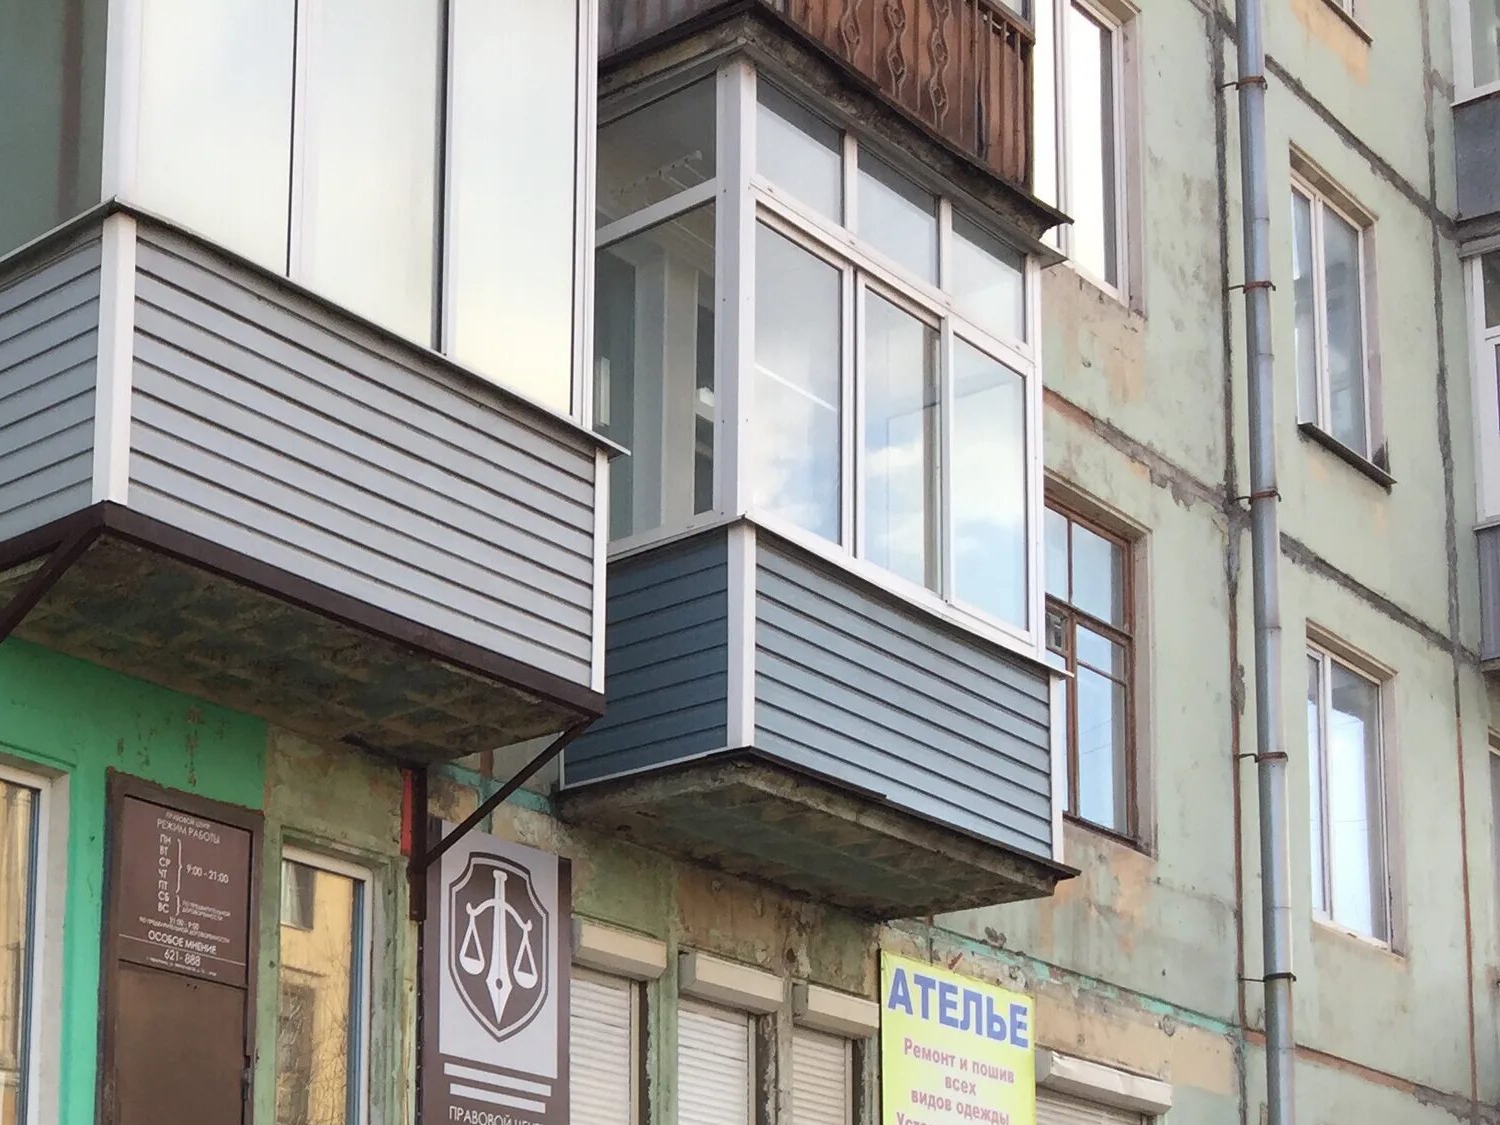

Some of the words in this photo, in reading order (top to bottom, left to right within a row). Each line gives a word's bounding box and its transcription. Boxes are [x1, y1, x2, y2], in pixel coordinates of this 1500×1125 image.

[156, 818, 187, 836] РЕЖИМ
[188, 827, 221, 845] РАБОТЫ
[159, 834, 172, 845] ПН
[159, 845, 169, 856] ВТ
[158, 856, 171, 867] СР
[158, 869, 168, 879] ЧТ
[186, 863, 203, 877] 9:00
[158, 880, 169, 891] ПТ
[157, 890, 170, 902] СБ
[157, 902, 170, 914] ВС
[148, 929, 184, 948] ОСОБОЕ
[185, 939, 218, 955] МНЕНИЕ
[887, 967, 1029, 1049] АТЕЛЬЕ
[904, 1038, 956, 1068] Ремонт
[960, 1058, 968, 1071] и
[972, 1060, 1014, 1084] пошив
[945, 1075, 977, 1096] всех
[911, 1089, 952, 1112] видов
